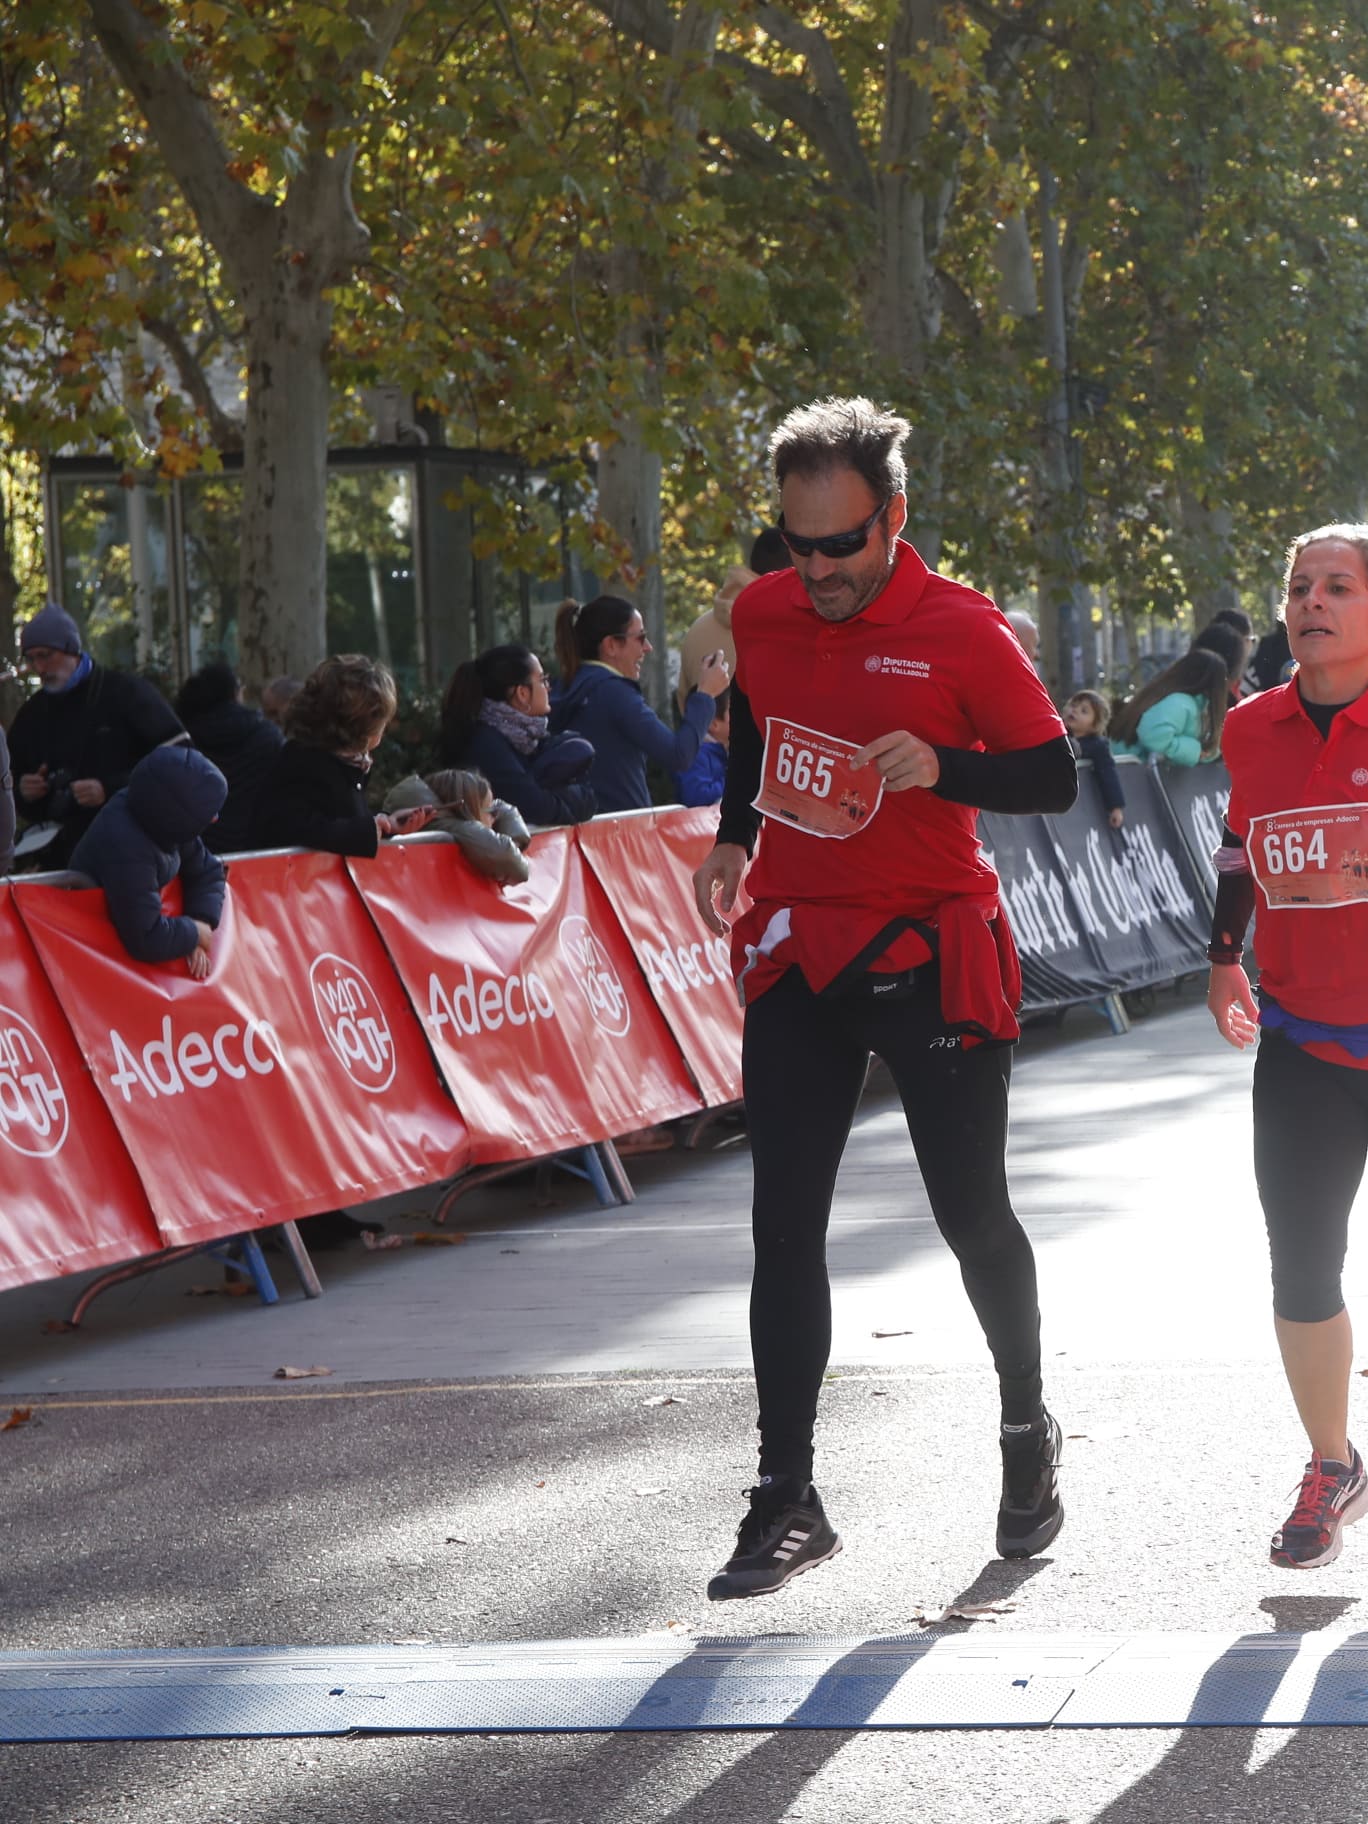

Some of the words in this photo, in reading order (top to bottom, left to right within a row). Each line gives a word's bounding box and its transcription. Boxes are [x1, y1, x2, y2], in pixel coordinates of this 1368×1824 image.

[776, 743, 835, 798] 665
[1304, 819, 1334, 827] empresas
[1336, 815, 1360, 823] Adecco
[1263, 829, 1328, 875] 664
[427, 964, 556, 1040] Adecco
[110, 1015, 285, 1102] Adecco
